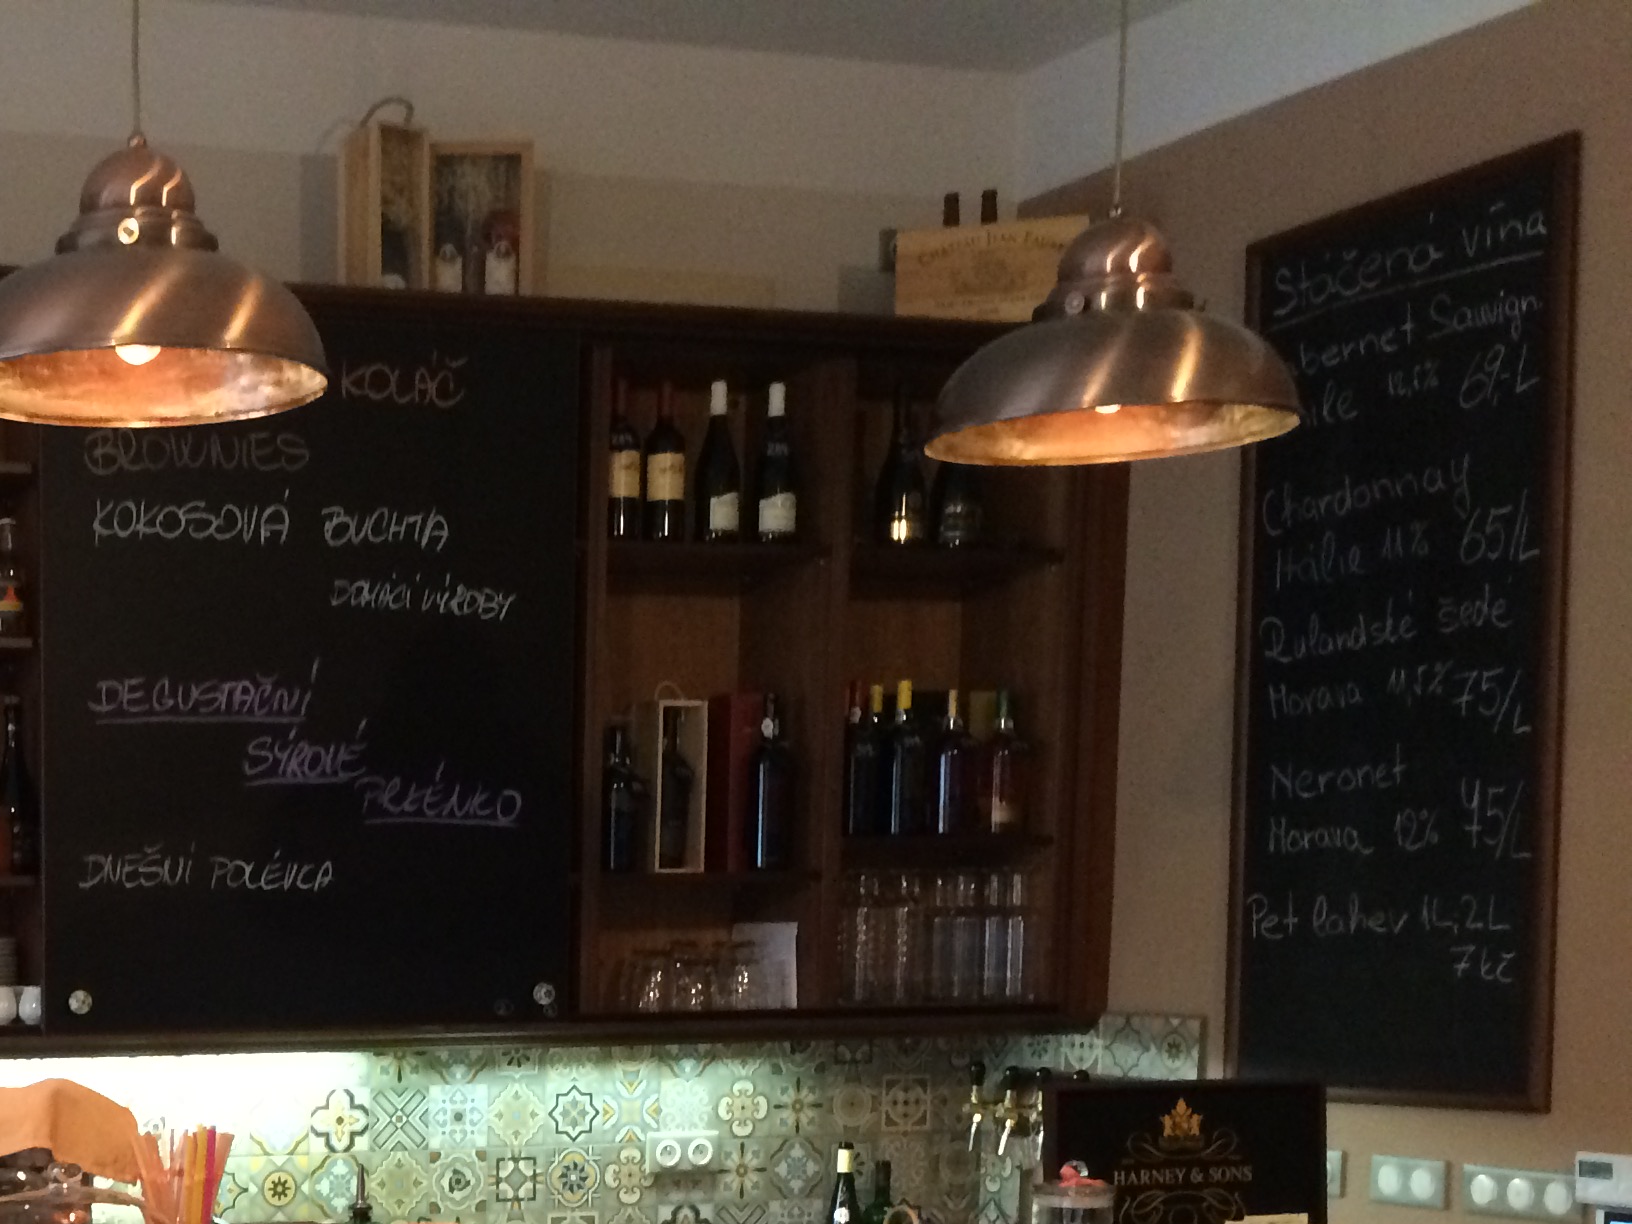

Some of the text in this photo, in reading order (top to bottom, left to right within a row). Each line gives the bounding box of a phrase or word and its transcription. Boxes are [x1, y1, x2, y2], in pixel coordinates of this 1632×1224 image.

[1295, 301, 1417, 376] bernet
[92, 488, 451, 553] KOKOSOVÁ BUCHTA
[1270, 742, 1407, 799] Neronet
[1247, 889, 1299, 940] Pet
[1113, 1164, 1253, 1187] HARNEY & SONS
